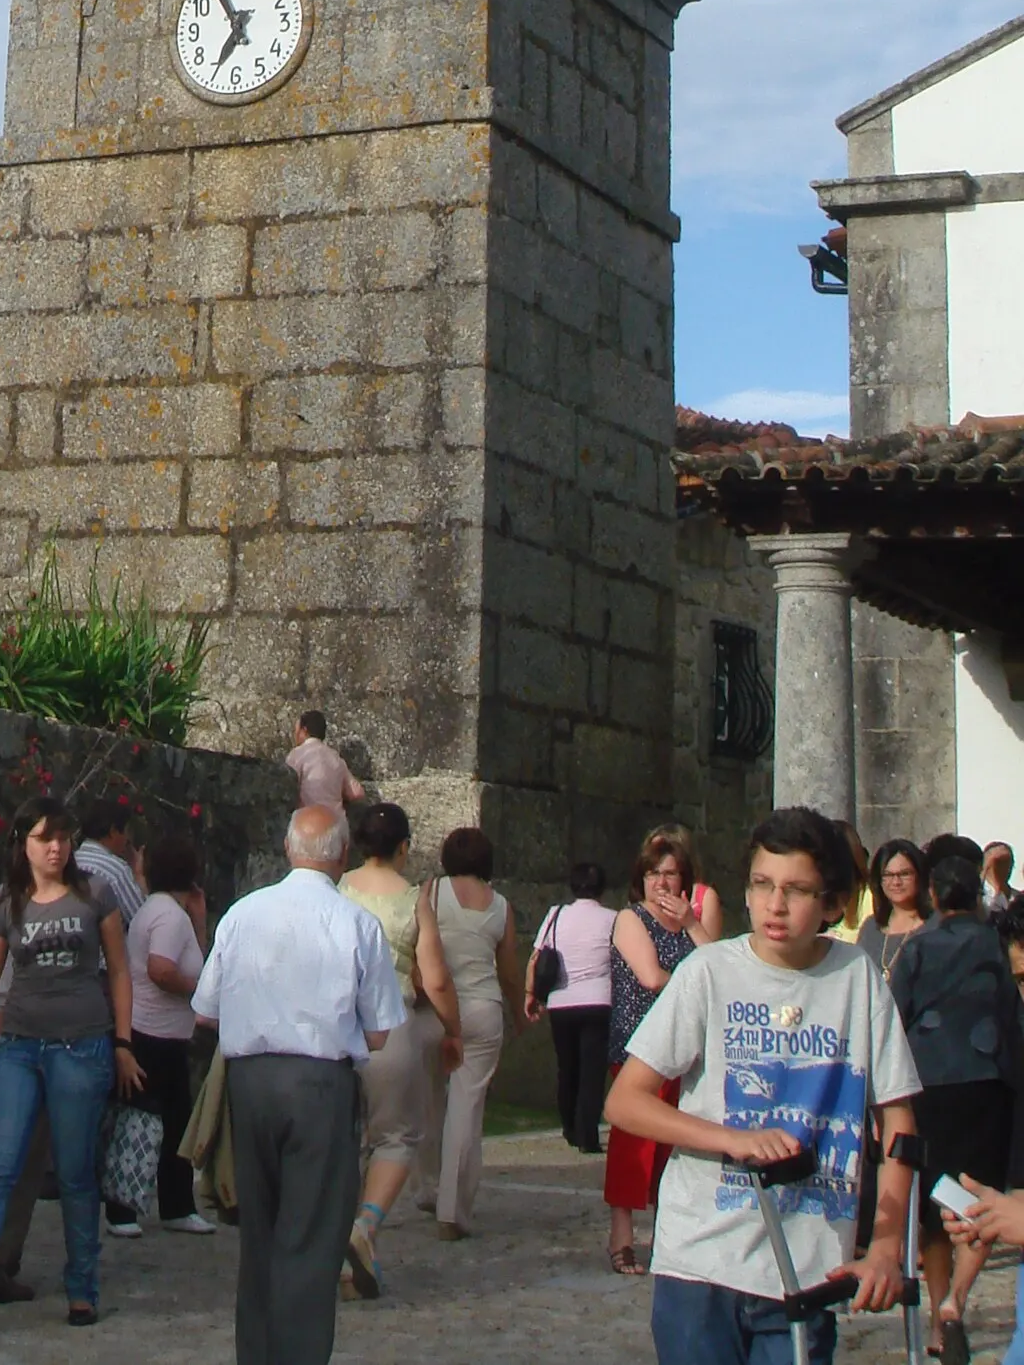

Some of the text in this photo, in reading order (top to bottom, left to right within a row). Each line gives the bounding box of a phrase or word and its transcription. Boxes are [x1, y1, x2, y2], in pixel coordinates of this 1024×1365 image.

[188, 22, 200, 42] 9
[279, 12, 291, 32] 3
[193, 46, 205, 66] 8
[269, 38, 281, 58] 4
[230, 65, 242, 85] 6
[254, 57, 266, 77] 5
[723, 1026, 760, 1047] 34TH
